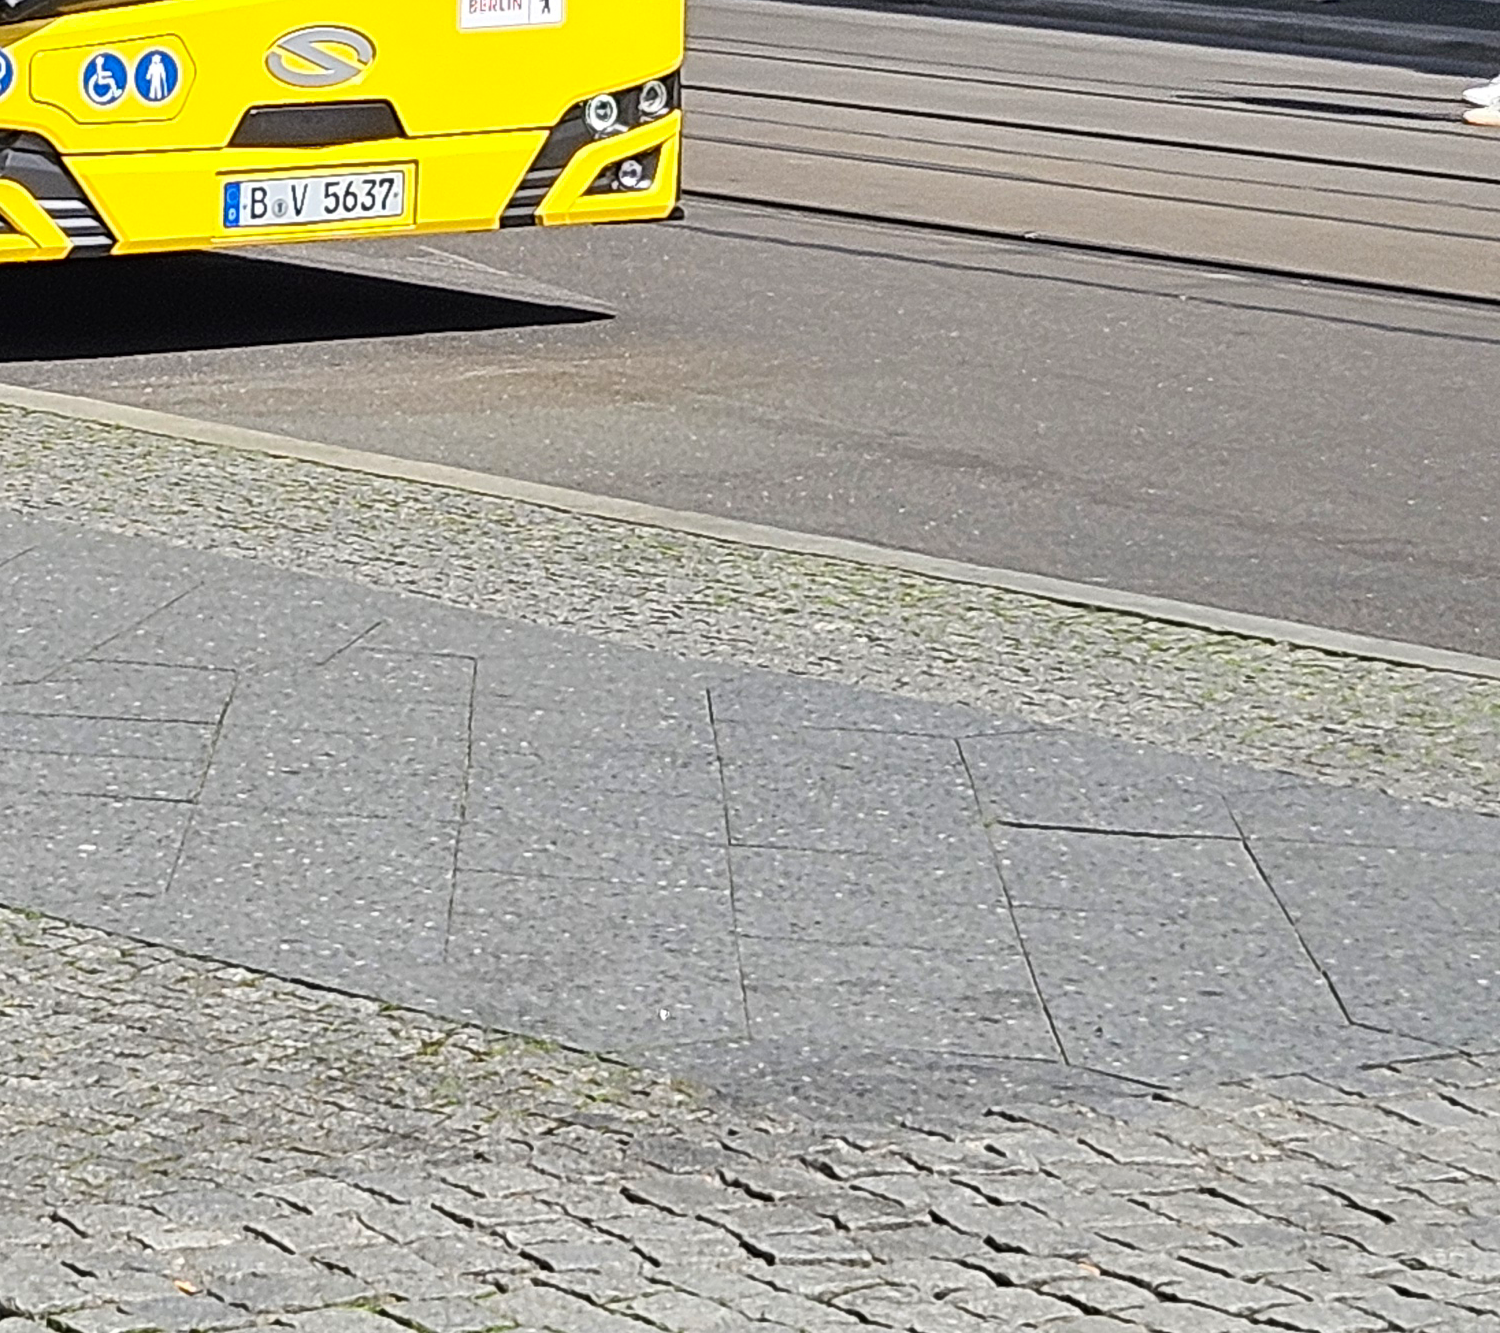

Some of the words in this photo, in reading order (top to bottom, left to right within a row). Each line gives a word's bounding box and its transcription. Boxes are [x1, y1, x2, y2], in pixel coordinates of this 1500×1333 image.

[250, 187, 268, 219] B
[291, 184, 308, 216] V
[324, 177, 395, 214] 5637
